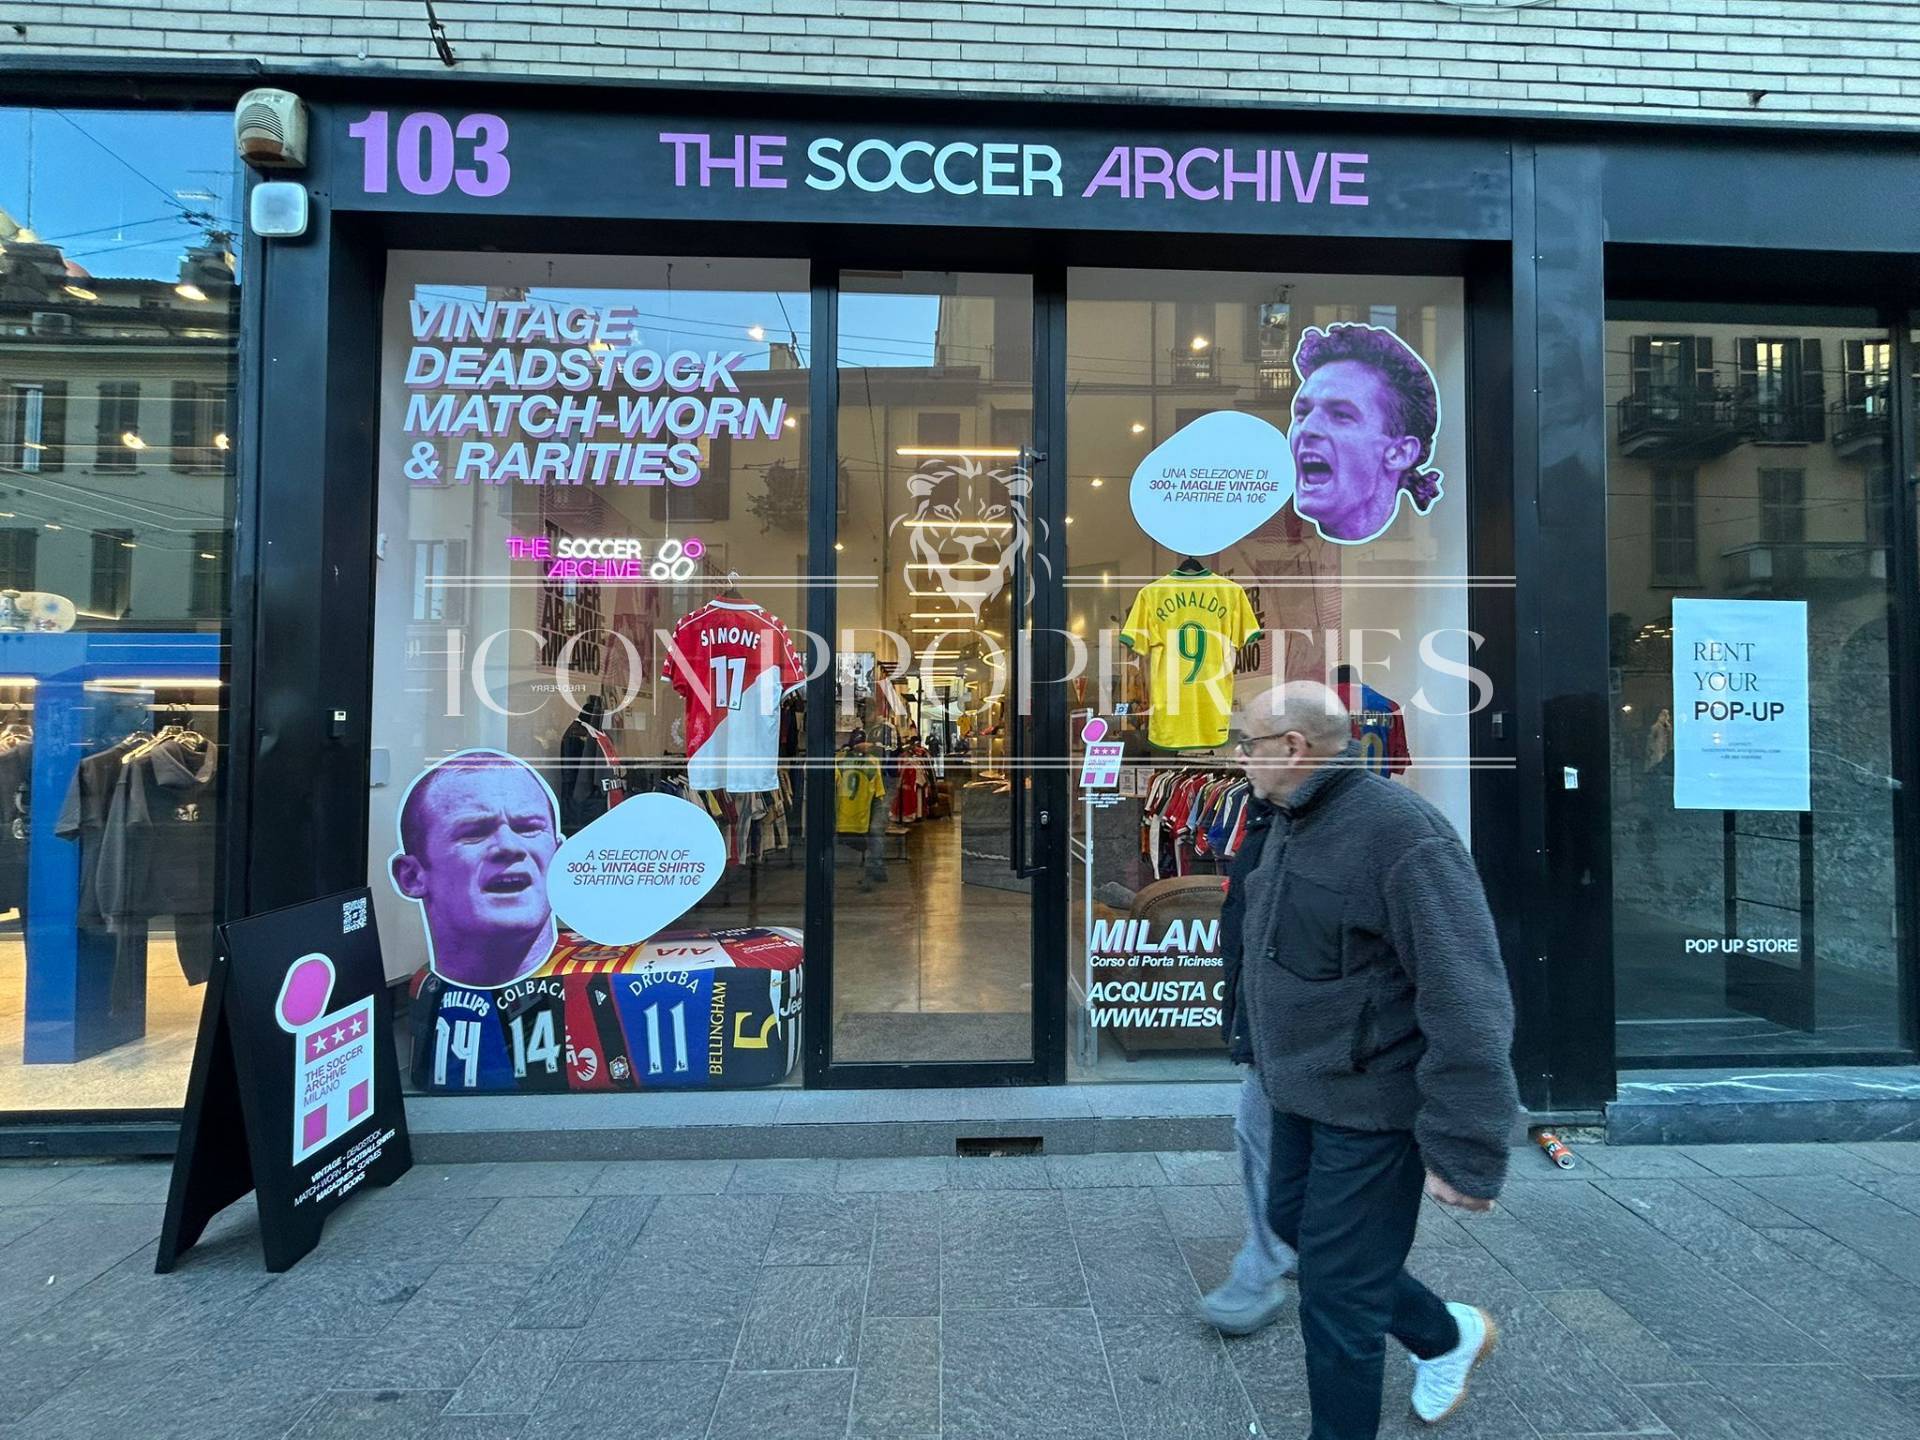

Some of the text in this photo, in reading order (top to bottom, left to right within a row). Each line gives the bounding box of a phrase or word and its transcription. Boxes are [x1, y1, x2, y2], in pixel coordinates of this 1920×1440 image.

[348, 110, 511, 197] 103
[659, 132, 1369, 206] THE SOCCER ARCHIVE
[408, 300, 638, 346] VINTAGE
[404, 347, 746, 393] DEADSTOCK
[403, 394, 787, 441] MATCH-WORN
[403, 442, 702, 487] & RARITIES
[1162, 468, 1269, 480] UNA SELEZIONE DI
[1149, 480, 1279, 492] 300+ MAGLIE VINTAGE
[1163, 492, 1267, 504] A PARTIRE DA 10€
[506, 538, 642, 559] THE SOCCER
[547, 560, 642, 579] ARCHIVE
[1155, 591, 1228, 622] RONALDO
[700, 626, 761, 650] SIMONE
[1693, 642, 1756, 662] RENT
[1177, 620, 1208, 685] 9
[710, 655, 747, 710] 11
[1693, 672, 1759, 692] YOUR
[1694, 701, 1784, 721] POP-UP
[567, 862, 705, 873] 300+ VINTAGE SHIRTS
[585, 850, 690, 861] A SELECTION OF
[573, 875, 701, 886] STARTING FROM 10€
[1089, 919, 1221, 954] MILAN
[1685, 938, 1798, 953] POP UP STORE
[1089, 955, 1224, 967] Corso di Porta Ticinese
[629, 970, 699, 996] DROGBA
[1087, 981, 1206, 1003] ACQUISTA
[441, 991, 491, 1017] HILLIPS
[1089, 1007, 1223, 1028] WWW.THES
[643, 1000, 689, 1076] 11
[709, 981, 728, 1075] BELLINGHAM
[434, 1016, 482, 1088] 14
[508, 1009, 562, 1078] 14
[305, 1045, 364, 1082] THE SOCCER
[304, 1079, 340, 1107] MILANO
[305, 1064, 347, 1095] ARCHIVE
[311, 1155, 342, 1182] VINTAGE
[347, 1128, 382, 1159] DEADSTOCK
[316, 1170, 353, 1202] MAGAZINES
